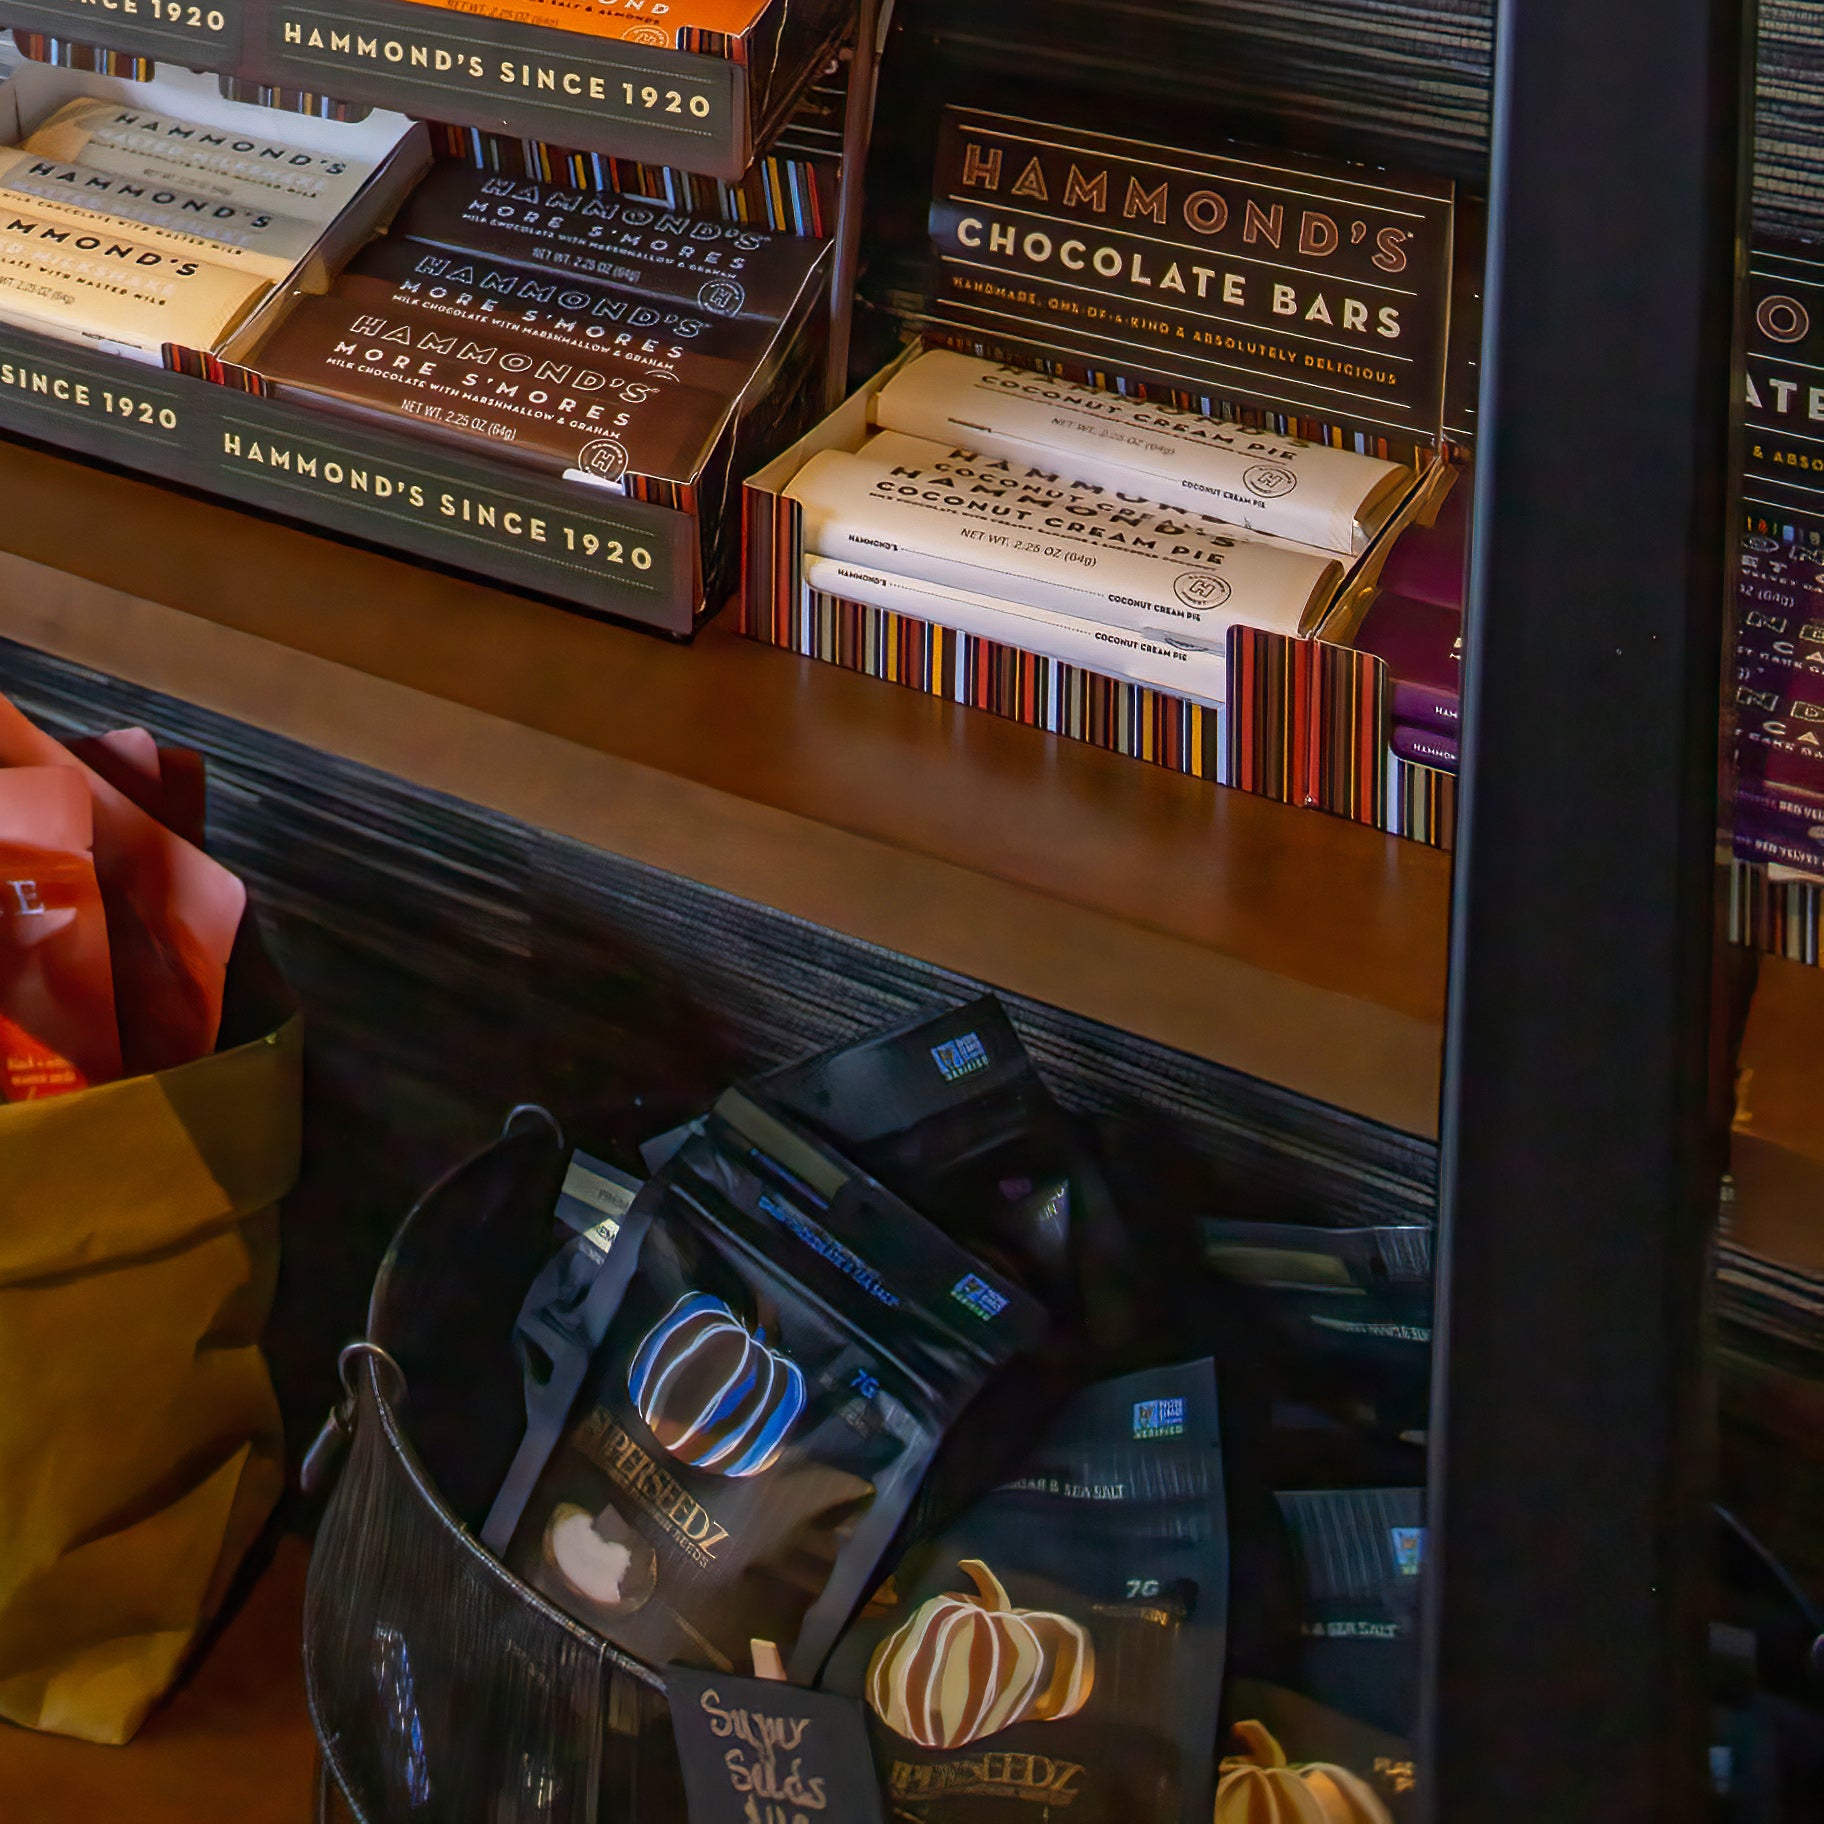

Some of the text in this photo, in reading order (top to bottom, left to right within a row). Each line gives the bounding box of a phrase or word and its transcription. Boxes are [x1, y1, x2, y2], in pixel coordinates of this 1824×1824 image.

[284, 21, 712, 119] HAMMOND'S SINCE 1920
[113, 112, 348, 176] HAMMOND'S
[29, 162, 275, 229] HAMMOND'S
[481, 176, 770, 252] HAMMOND'S
[960, 142, 1415, 274] HAMMOND'S
[467, 200, 747, 271] MORE S'MORES
[415, 254, 713, 339] HAMMOND'S
[957, 216, 1403, 340] CHOCOLATE BARS
[399, 278, 684, 360] MORE S'MORES
[422, 298, 488, 325] CHOCOLATE
[491, 317, 518, 331] WITH
[334, 341, 631, 428] MORE S'MORES
[350, 314, 661, 405] HAMMOND'S
[1192, 329, 1297, 364] ABSOLUTELY
[1304, 352, 1398, 386] DELICIOUS
[1, 364, 91, 407] SINCE
[102, 390, 178, 431] 1920
[326, 357, 621, 440] MILK CHOCOLATE WITH MARSHMALLOW GRAHAM
[401, 398, 517, 442] NET WT. 2.25 OZ (64g)
[981, 374, 1299, 461] COCONUT CREAM PIE
[224, 432, 653, 572] HAMMOND'S SINCE 1920
[935, 462, 1077, 503] COCONUT
[1181, 480, 1221, 496] COCONUT
[876, 480, 1032, 521] COCONUT
[1044, 516, 1157, 551] CREAM
[1171, 544, 1225, 566] PIE
[960, 527, 986, 542] NET
[988, 532, 1011, 548] WT.
[1043, 545, 1062, 559] OZ
[1108, 593, 1152, 611] COCONUT
[1154, 604, 1185, 619] CREAM
[1187, 612, 1201, 622] PIE
[1095, 631, 1139, 649] COCONUT
[1140, 642, 1171, 656] CREAM
[1173, 651, 1188, 662] PIE
[1127, 1580, 1159, 1598] 7G
